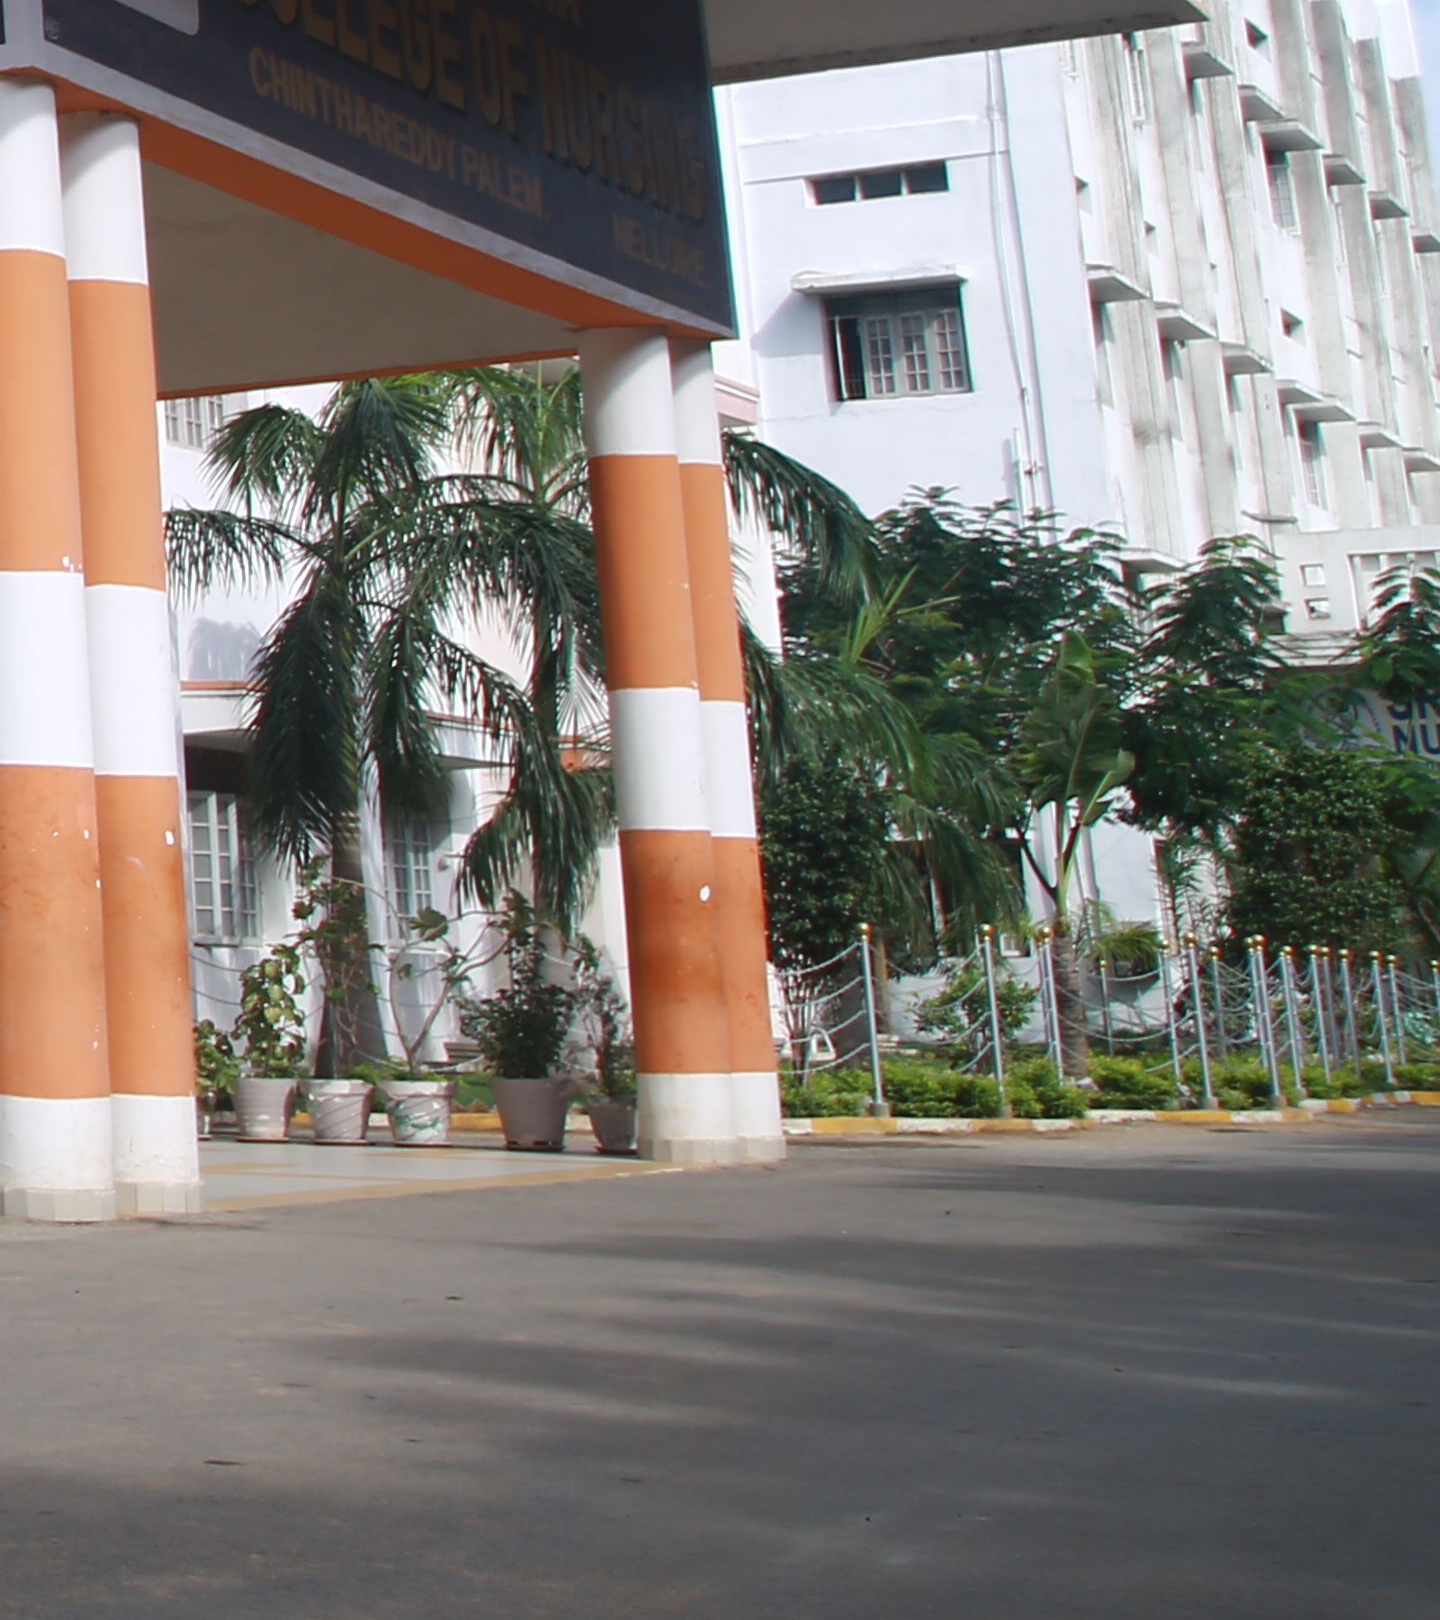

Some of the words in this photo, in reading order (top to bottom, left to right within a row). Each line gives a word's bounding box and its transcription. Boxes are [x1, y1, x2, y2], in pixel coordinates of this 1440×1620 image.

[249, 46, 456, 179] CHINTHAREDDY
[470, 5, 529, 135] OF
[535, 35, 705, 222] NURSING
